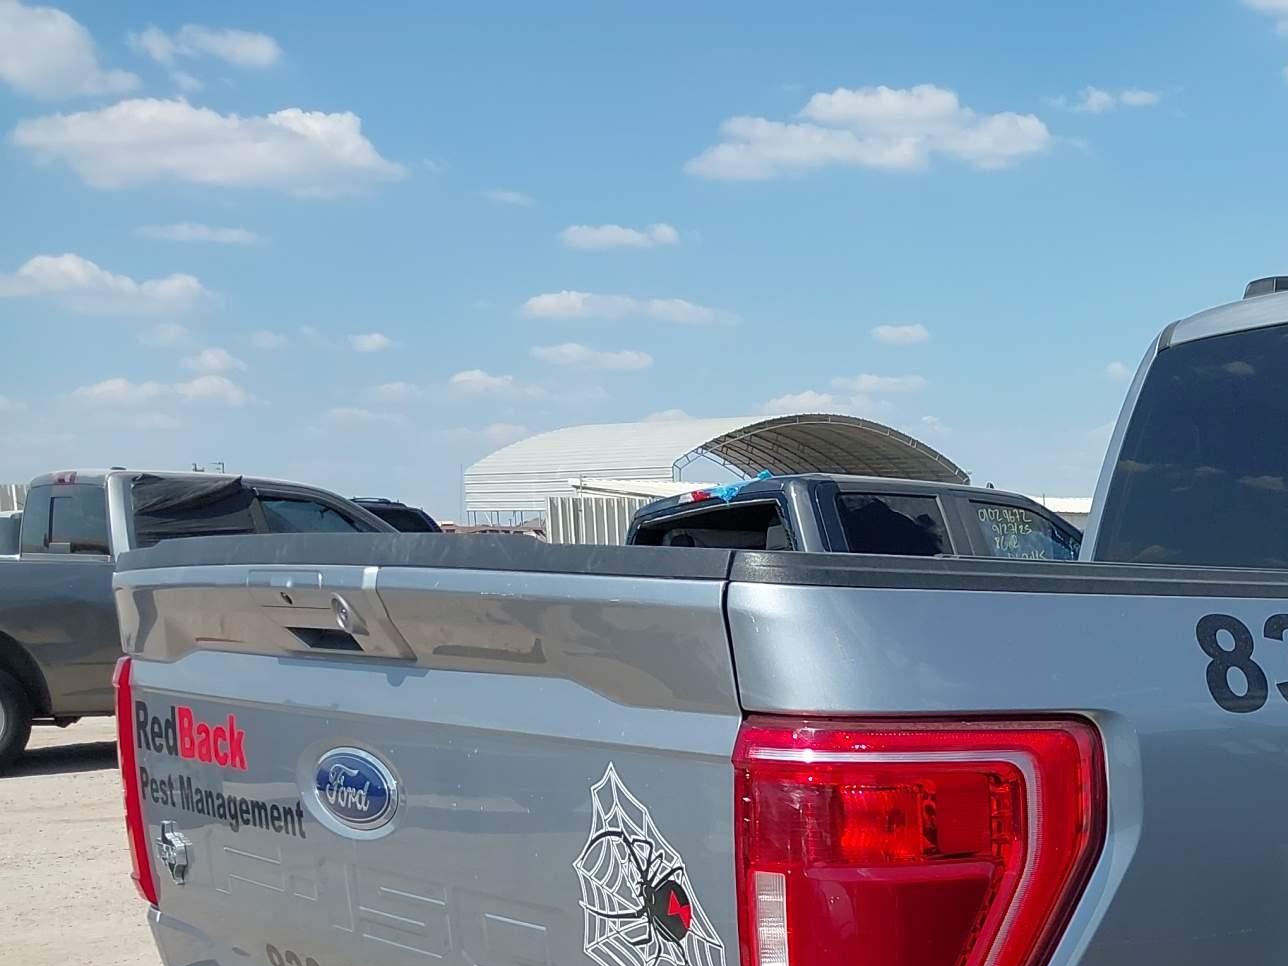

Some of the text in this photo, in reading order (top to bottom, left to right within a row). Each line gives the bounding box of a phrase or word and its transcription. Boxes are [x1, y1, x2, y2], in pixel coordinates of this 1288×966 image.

[135, 700, 248, 771] RedBack
[139, 766, 306, 839] Pest Management
[325, 763, 370, 812] Ford
